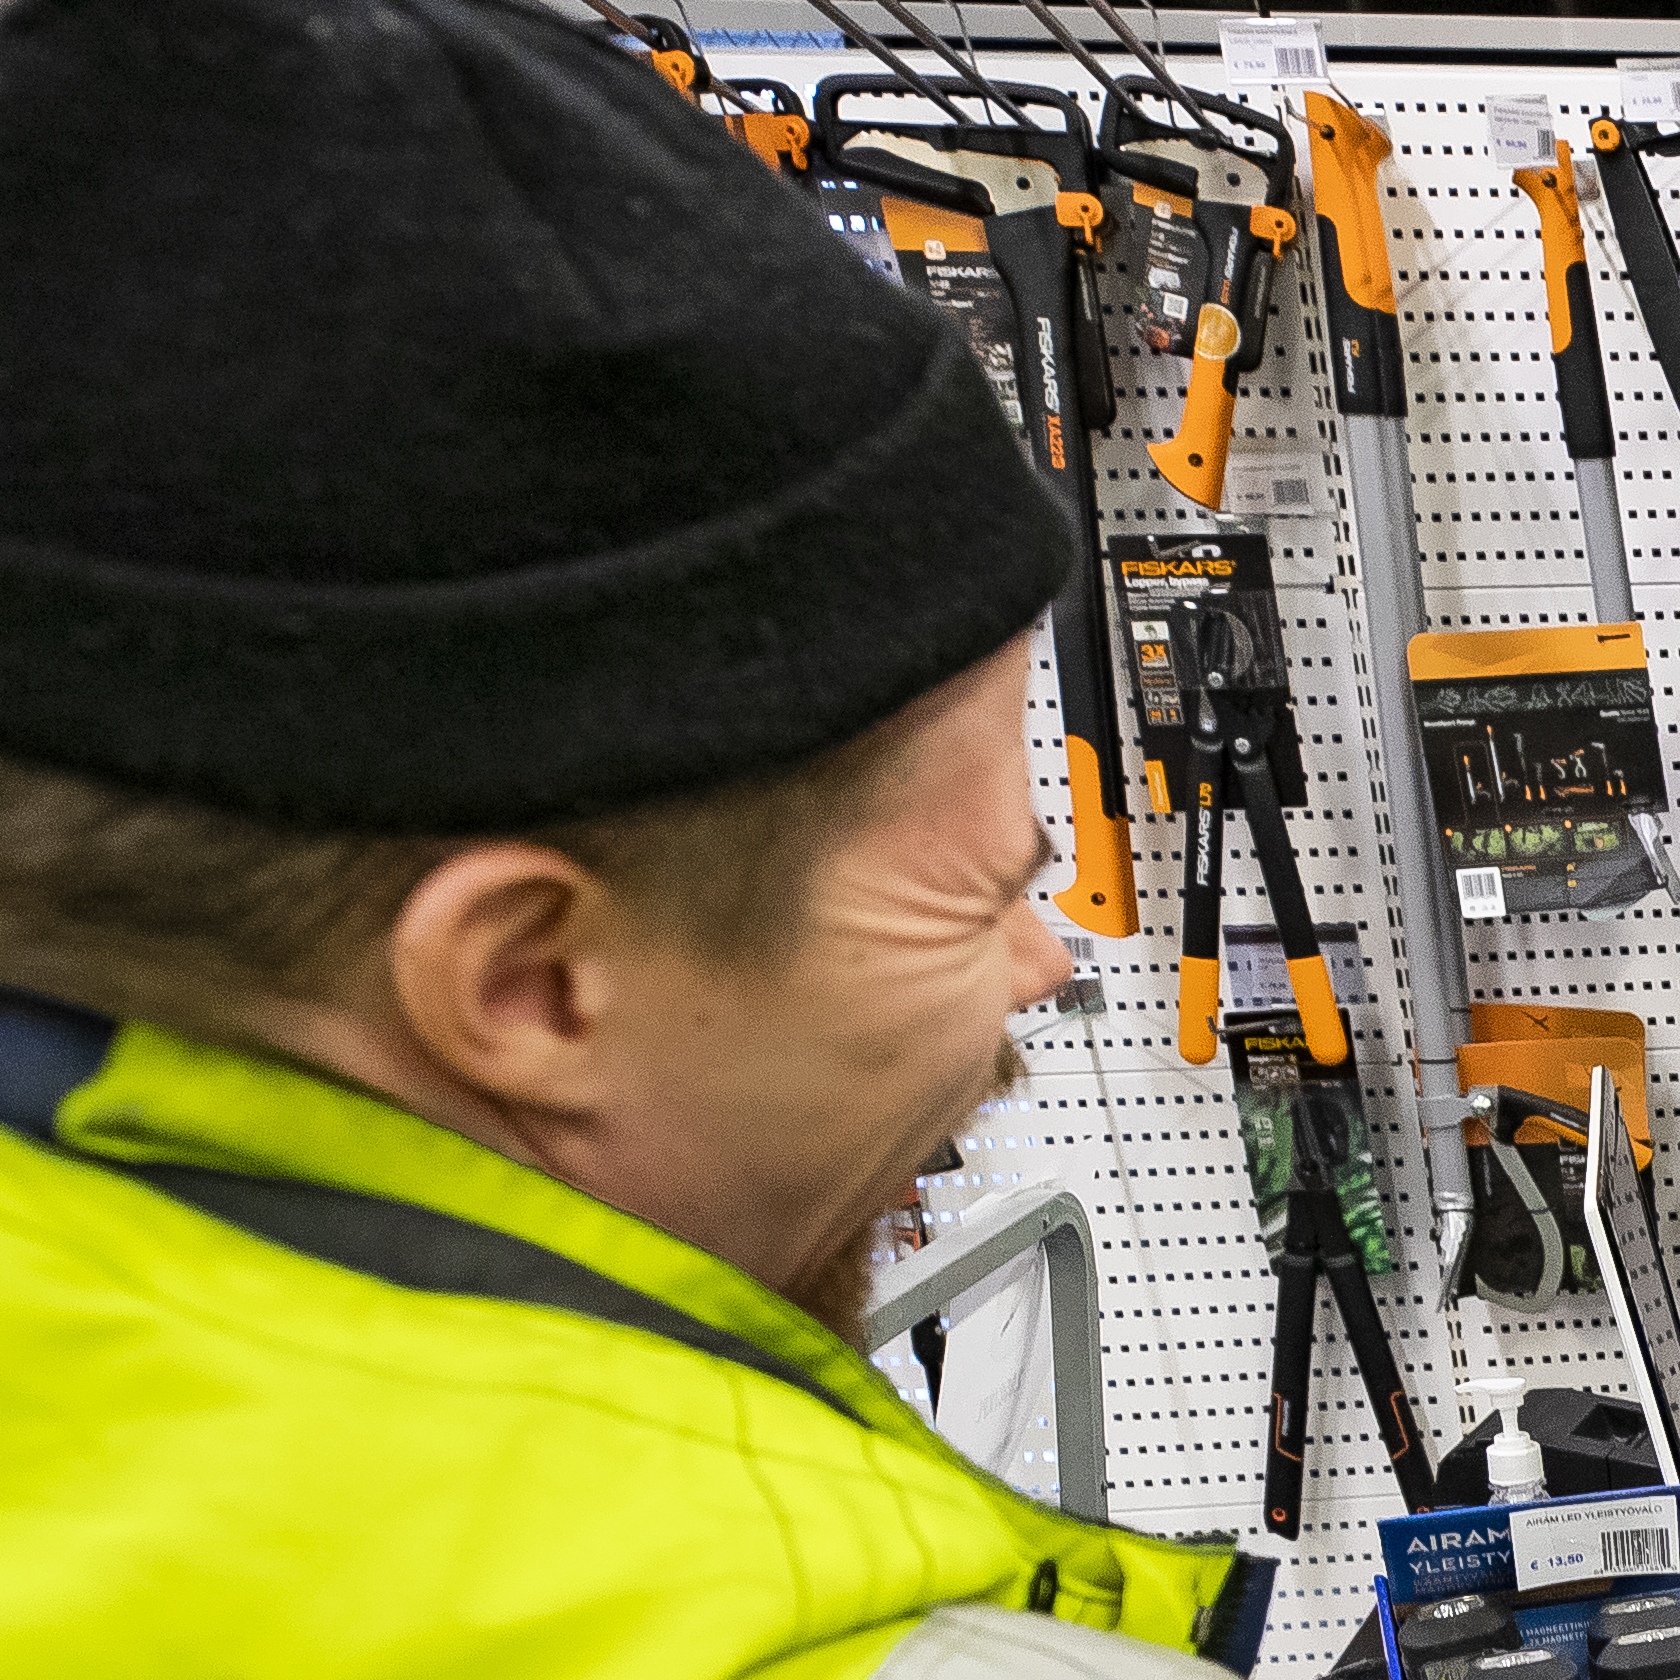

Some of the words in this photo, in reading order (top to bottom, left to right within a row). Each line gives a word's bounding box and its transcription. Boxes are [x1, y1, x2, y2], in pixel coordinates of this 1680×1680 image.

[1037, 316, 1060, 414] FISKARS
[1122, 560, 1233, 576] FISKARS
[1197, 808, 1211, 886] FISKARS
[1245, 1036, 1307, 1050] FISKA
[1525, 1515, 1560, 1528] AIRAM
[1561, 1512, 1582, 1523] LED
[1406, 1527, 1511, 1556] AIRAM
[1409, 1551, 1511, 1576] YLEISTY
